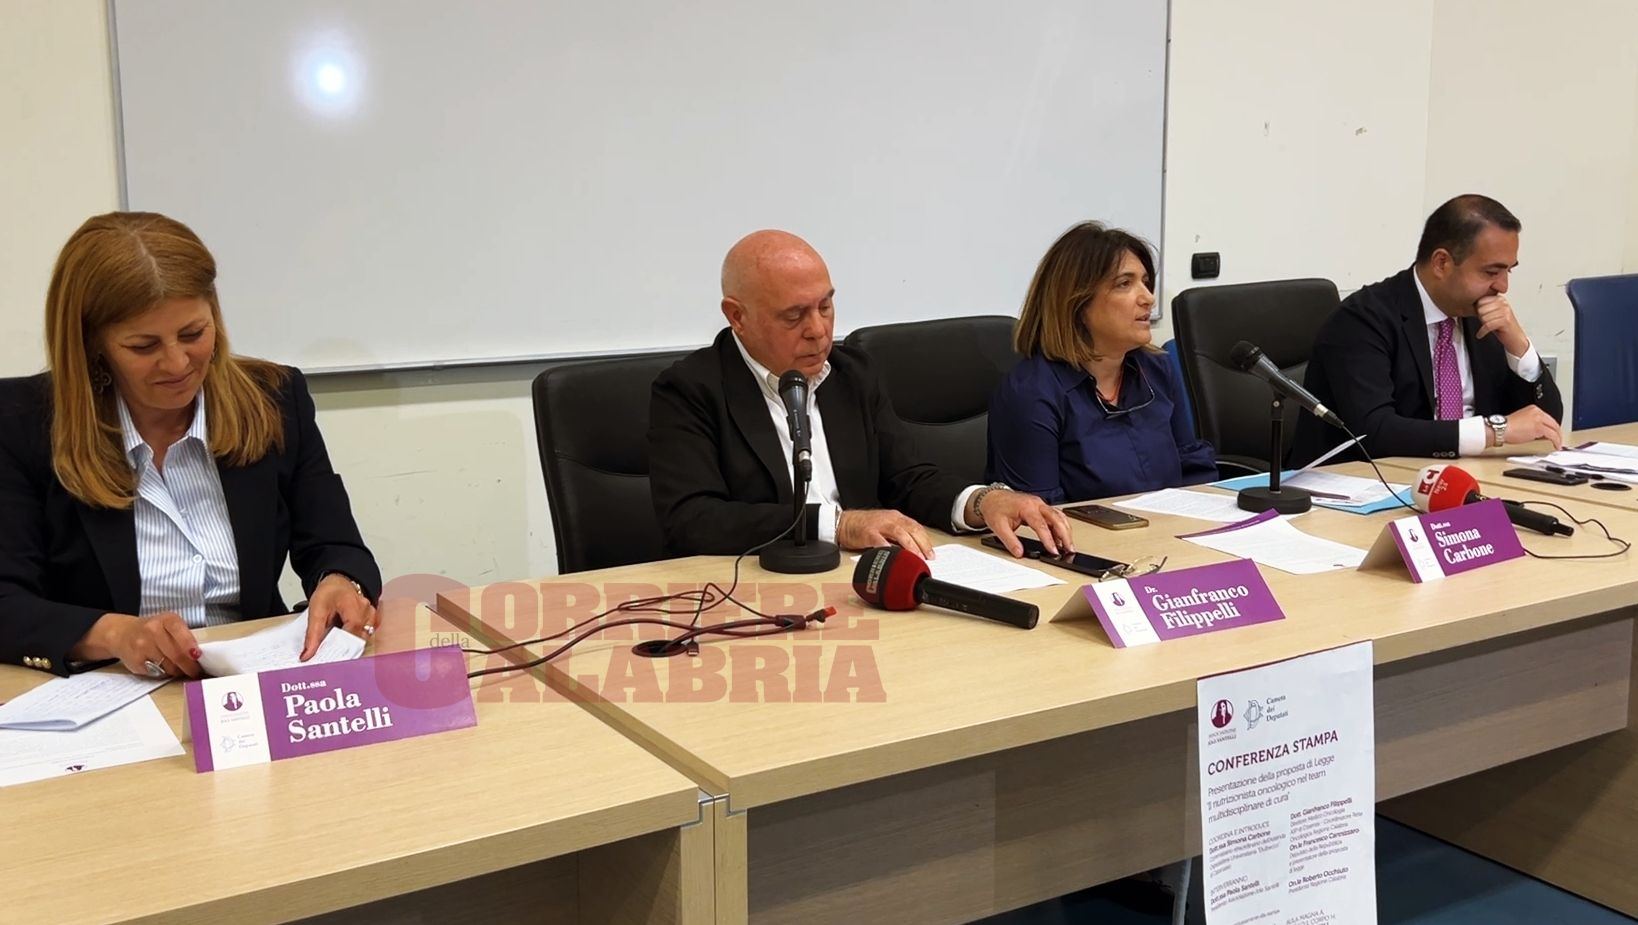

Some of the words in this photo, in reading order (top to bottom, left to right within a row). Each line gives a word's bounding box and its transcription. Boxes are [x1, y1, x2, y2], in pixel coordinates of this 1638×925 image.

[1435, 528, 1481, 547] Simona
[1444, 544, 1494, 564] Carbone
[1144, 586, 1158, 595] Dr.
[1152, 583, 1249, 612] Gianfranco
[1160, 602, 1241, 630] Filippelli
[281, 680, 327, 693] Dott.ssa
[283, 688, 362, 718] Paola
[288, 706, 393, 743] Santelli
[1208, 744, 1289, 776] CONFERENZA
[1293, 730, 1338, 753] STAMPA
[1208, 775, 1257, 797] Presentazione
[1258, 771, 1275, 784] della
[1276, 763, 1305, 781] proposta
[1314, 754, 1335, 768] Legge
[1213, 790, 1256, 808] nutrizionista
[1257, 779, 1296, 797] oncologico
[1297, 774, 1308, 785] nel
